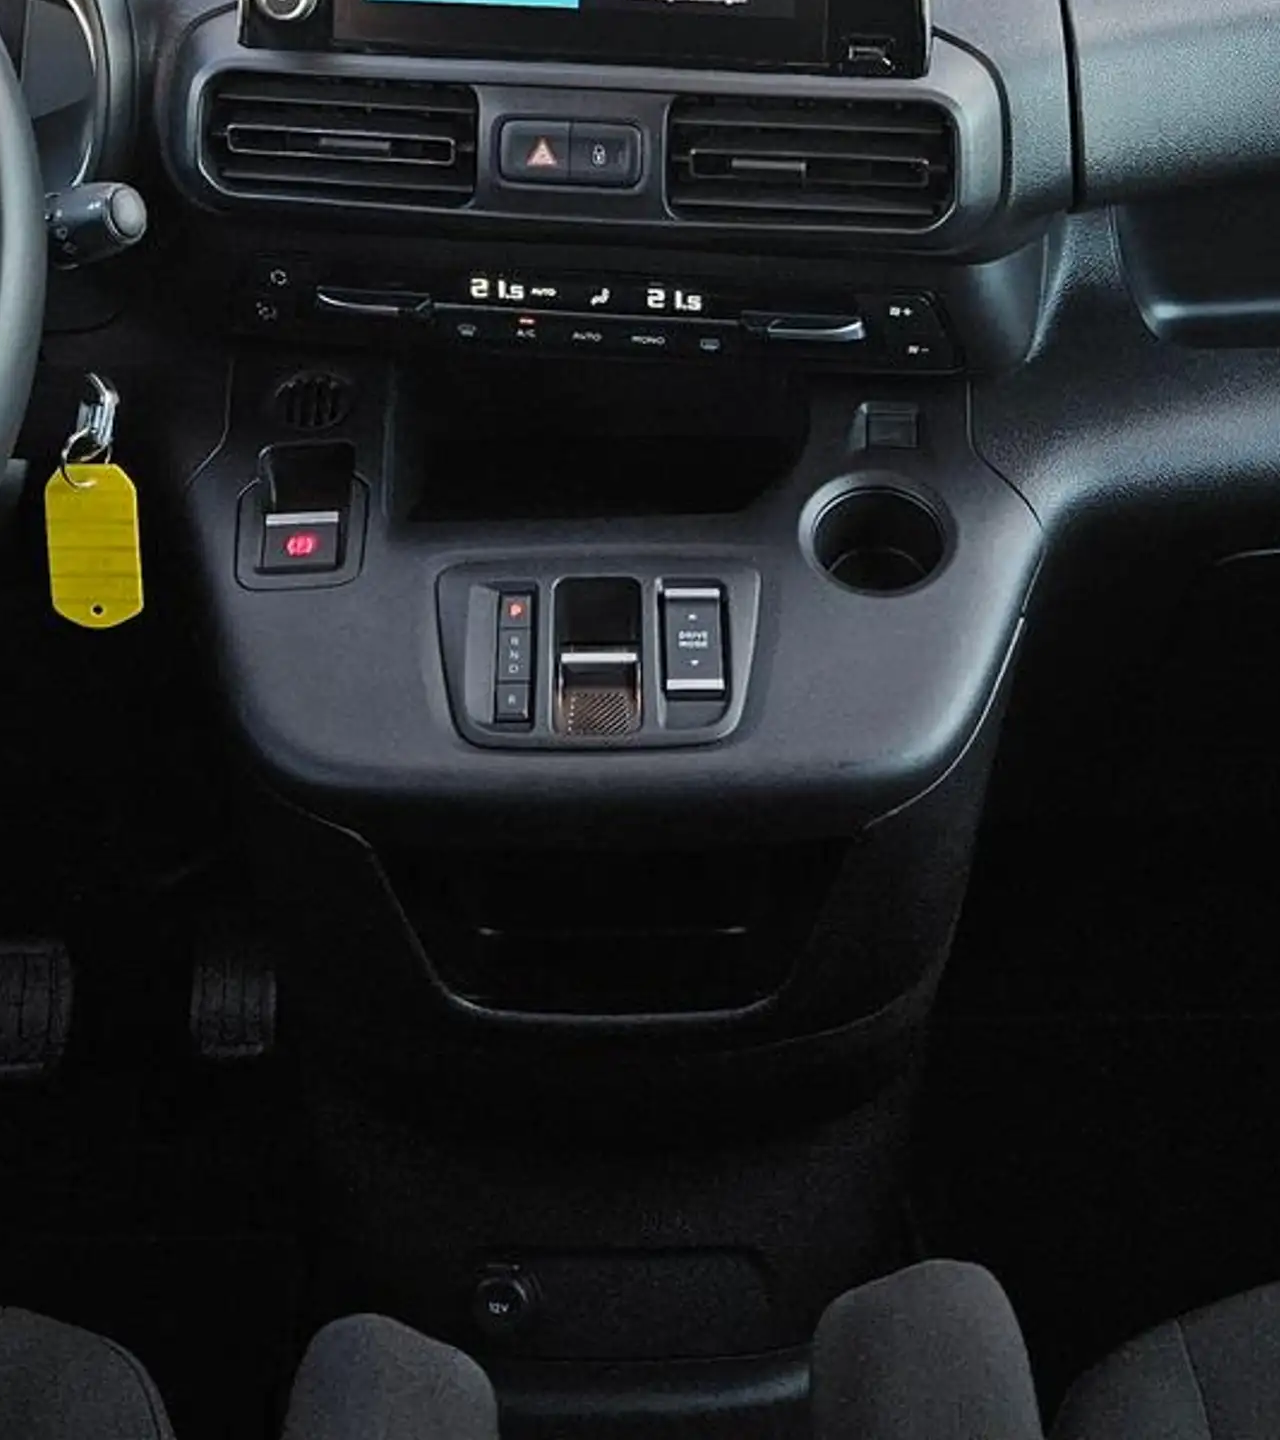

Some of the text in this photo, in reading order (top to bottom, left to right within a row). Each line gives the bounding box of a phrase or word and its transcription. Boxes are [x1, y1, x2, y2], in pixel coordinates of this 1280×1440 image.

[516, 329, 536, 338] A/C
[572, 332, 602, 342] AUTO
[631, 336, 666, 346] MONO
